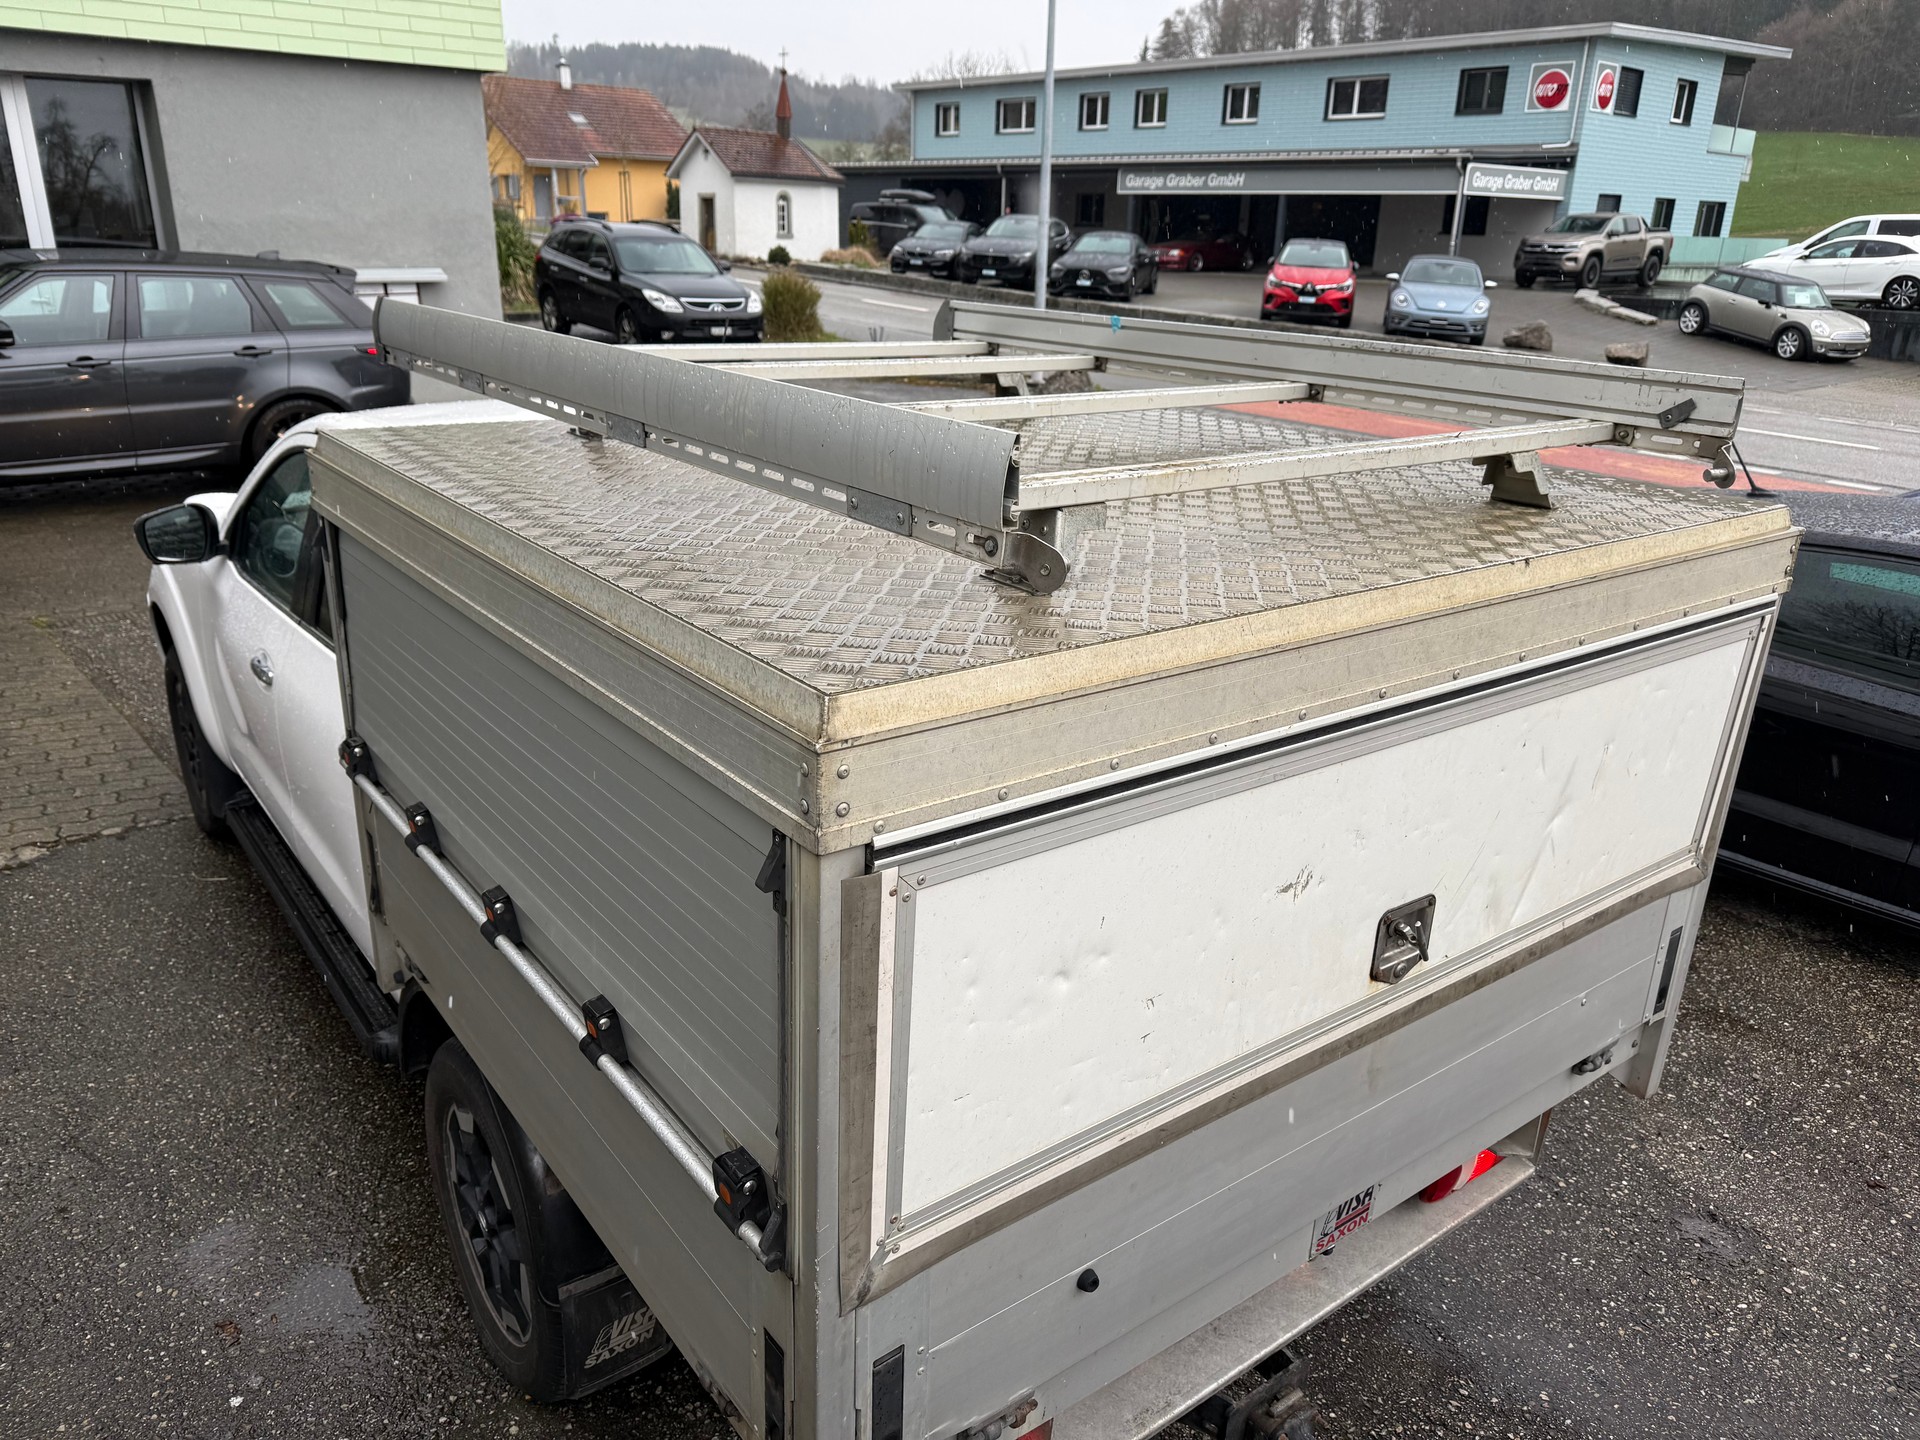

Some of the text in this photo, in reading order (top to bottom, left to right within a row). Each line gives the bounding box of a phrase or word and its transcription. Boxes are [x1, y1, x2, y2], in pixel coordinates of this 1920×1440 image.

[1126, 172, 1245, 190] Garage Graber GmbH
[1473, 171, 1559, 191] Garage Graber GmbH
[1336, 1184, 1374, 1221] VISA
[1315, 1212, 1369, 1252] SAXON
[584, 1328, 654, 1369] SAXON
